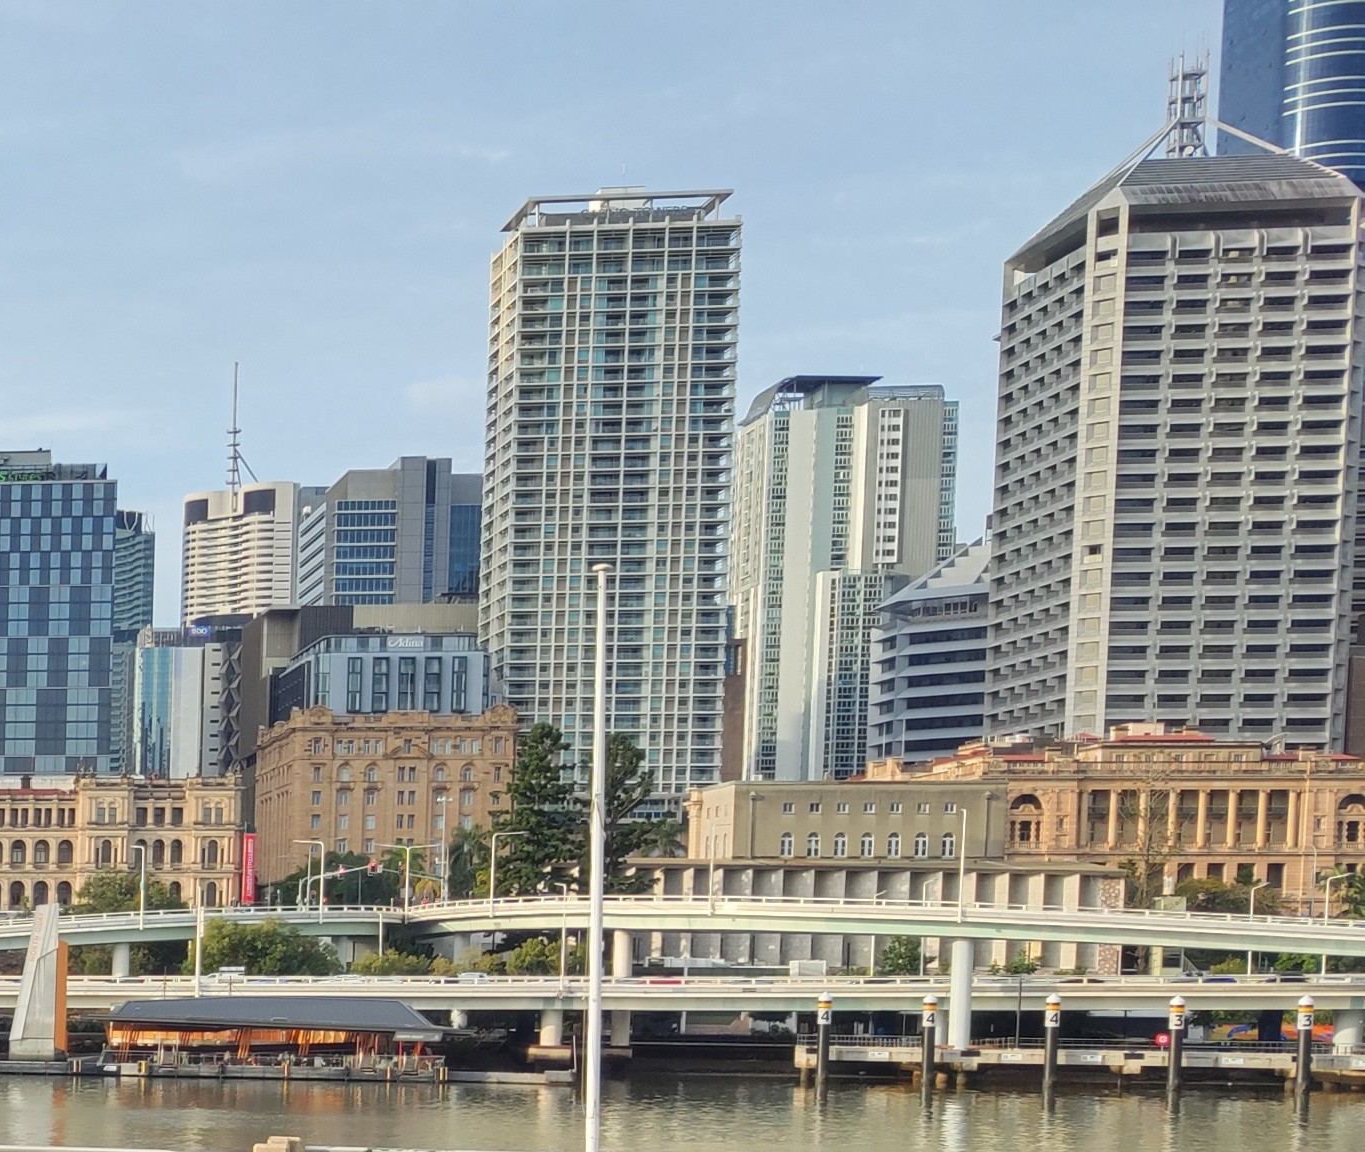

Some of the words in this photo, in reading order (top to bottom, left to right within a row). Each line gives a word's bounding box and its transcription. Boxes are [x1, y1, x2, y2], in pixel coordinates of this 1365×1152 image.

[388, 637, 424, 648] Adina
[820, 1010, 830, 1023] 4
[925, 1012, 935, 1024] 4
[1049, 1012, 1059, 1025] 4
[1173, 1014, 1183, 1027] 3
[1302, 1014, 1312, 1027] 3
